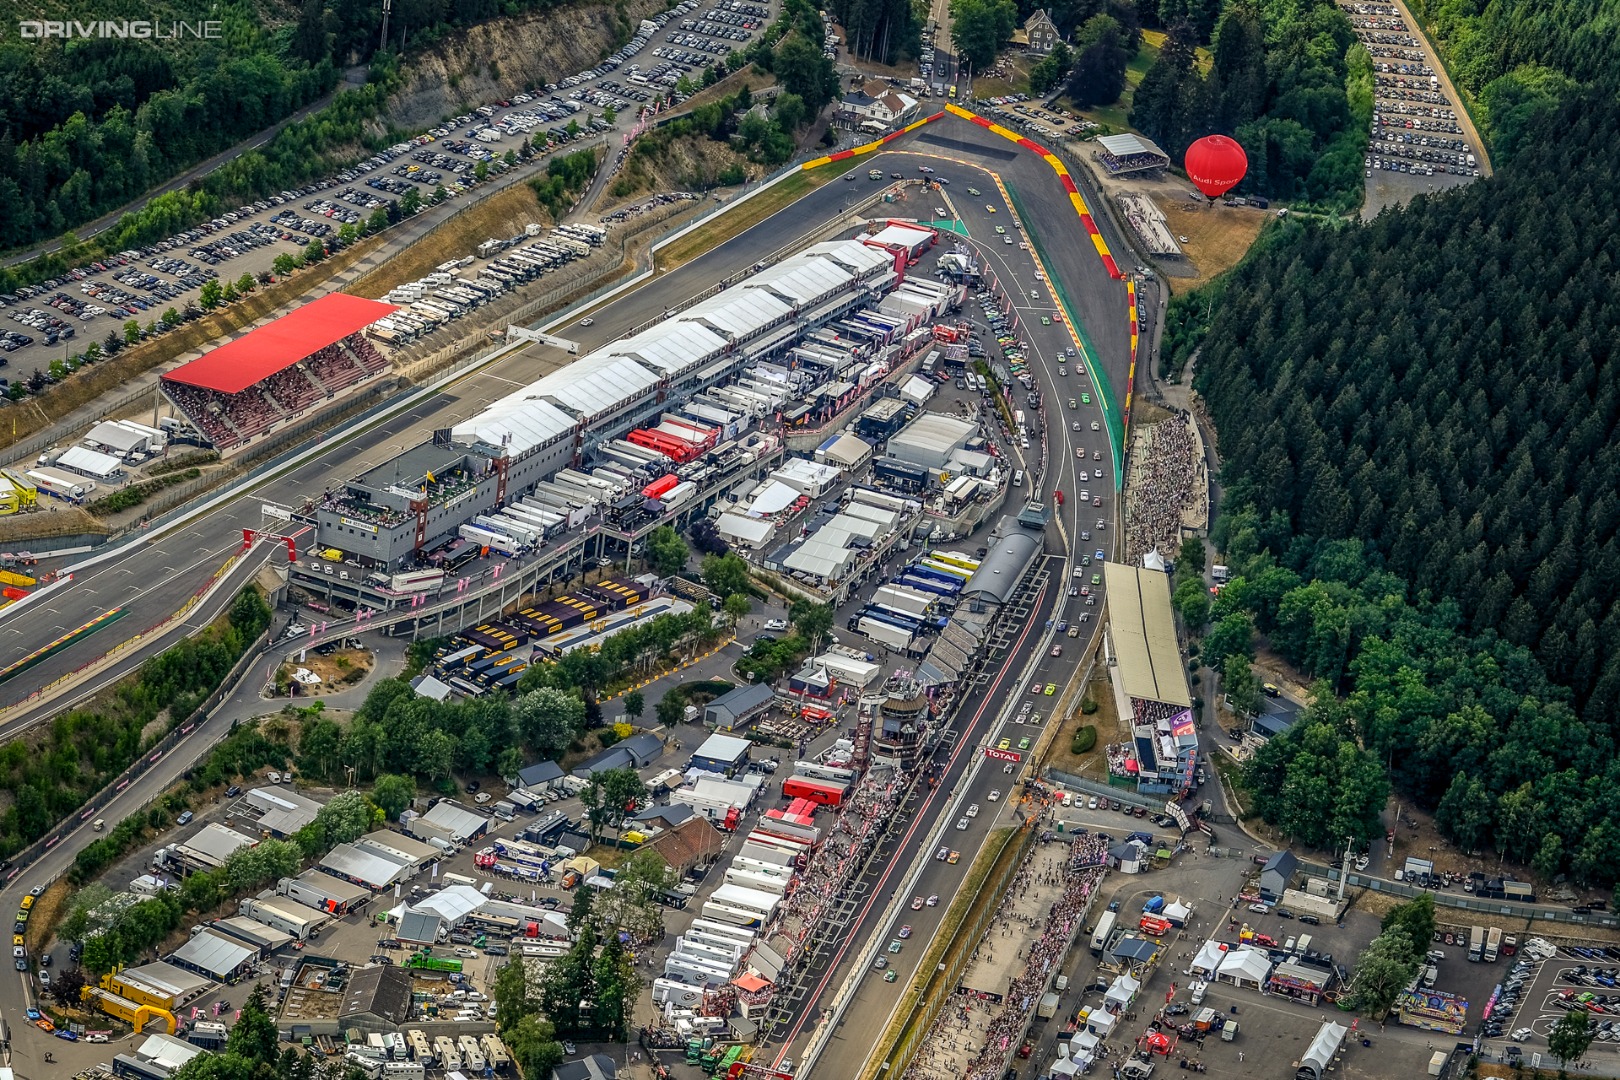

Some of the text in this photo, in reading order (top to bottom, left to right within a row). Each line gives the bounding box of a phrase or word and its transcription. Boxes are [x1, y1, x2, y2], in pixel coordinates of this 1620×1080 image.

[1193, 174, 1239, 187] Audi Sport
[830, 668, 847, 678] GDL
[987, 749, 1017, 762] TOTAL
